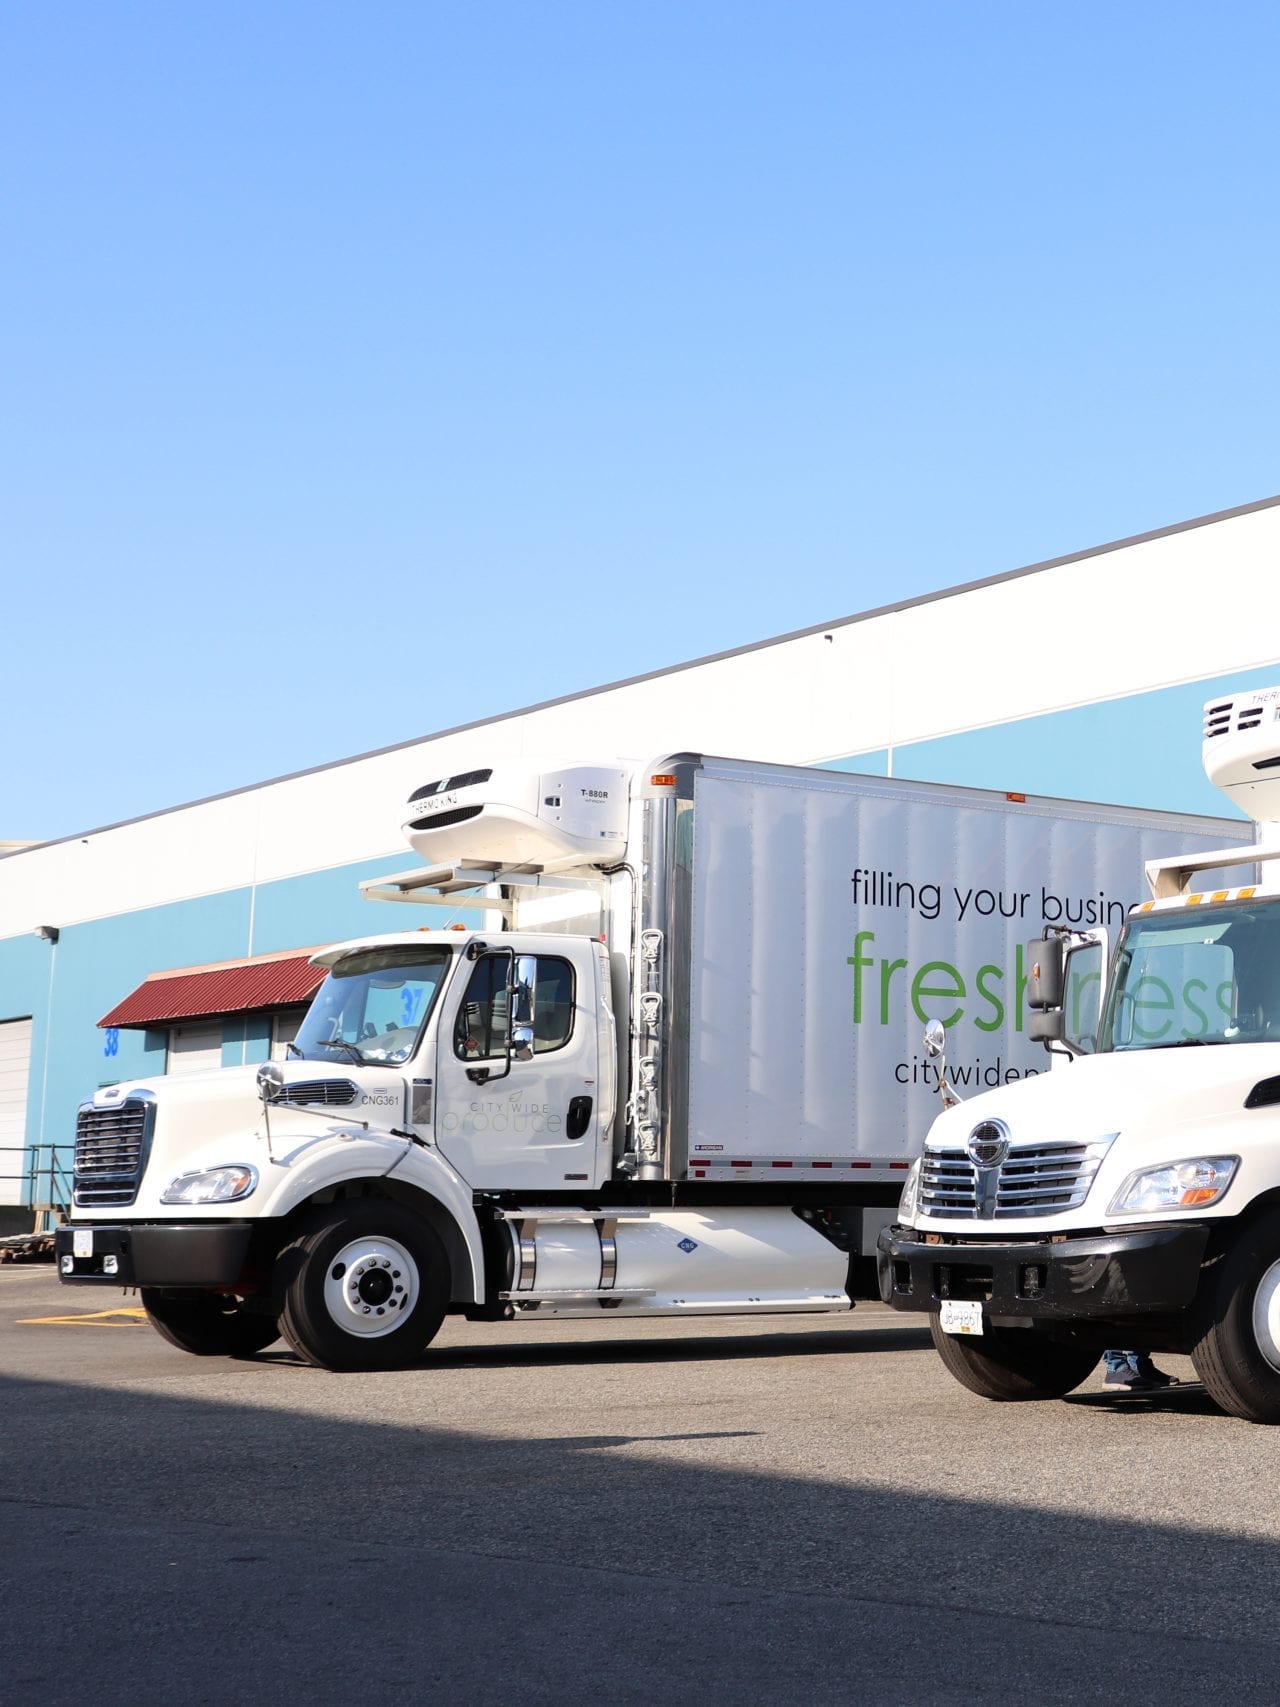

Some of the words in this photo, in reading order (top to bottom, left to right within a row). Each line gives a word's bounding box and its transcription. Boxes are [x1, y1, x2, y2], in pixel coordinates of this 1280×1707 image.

[580, 788, 609, 799] T-880R
[851, 868, 941, 920] filling
[953, 886, 1031, 922] your
[400, 987, 424, 1027] 37
[104, 1027, 119, 1057] 38
[894, 1056, 1048, 1094] citywide
[361, 1095, 400, 1106] CNG361
[470, 1102, 502, 1112] CITY
[511, 1103, 550, 1114] WIDE
[441, 1107, 562, 1140] produce
